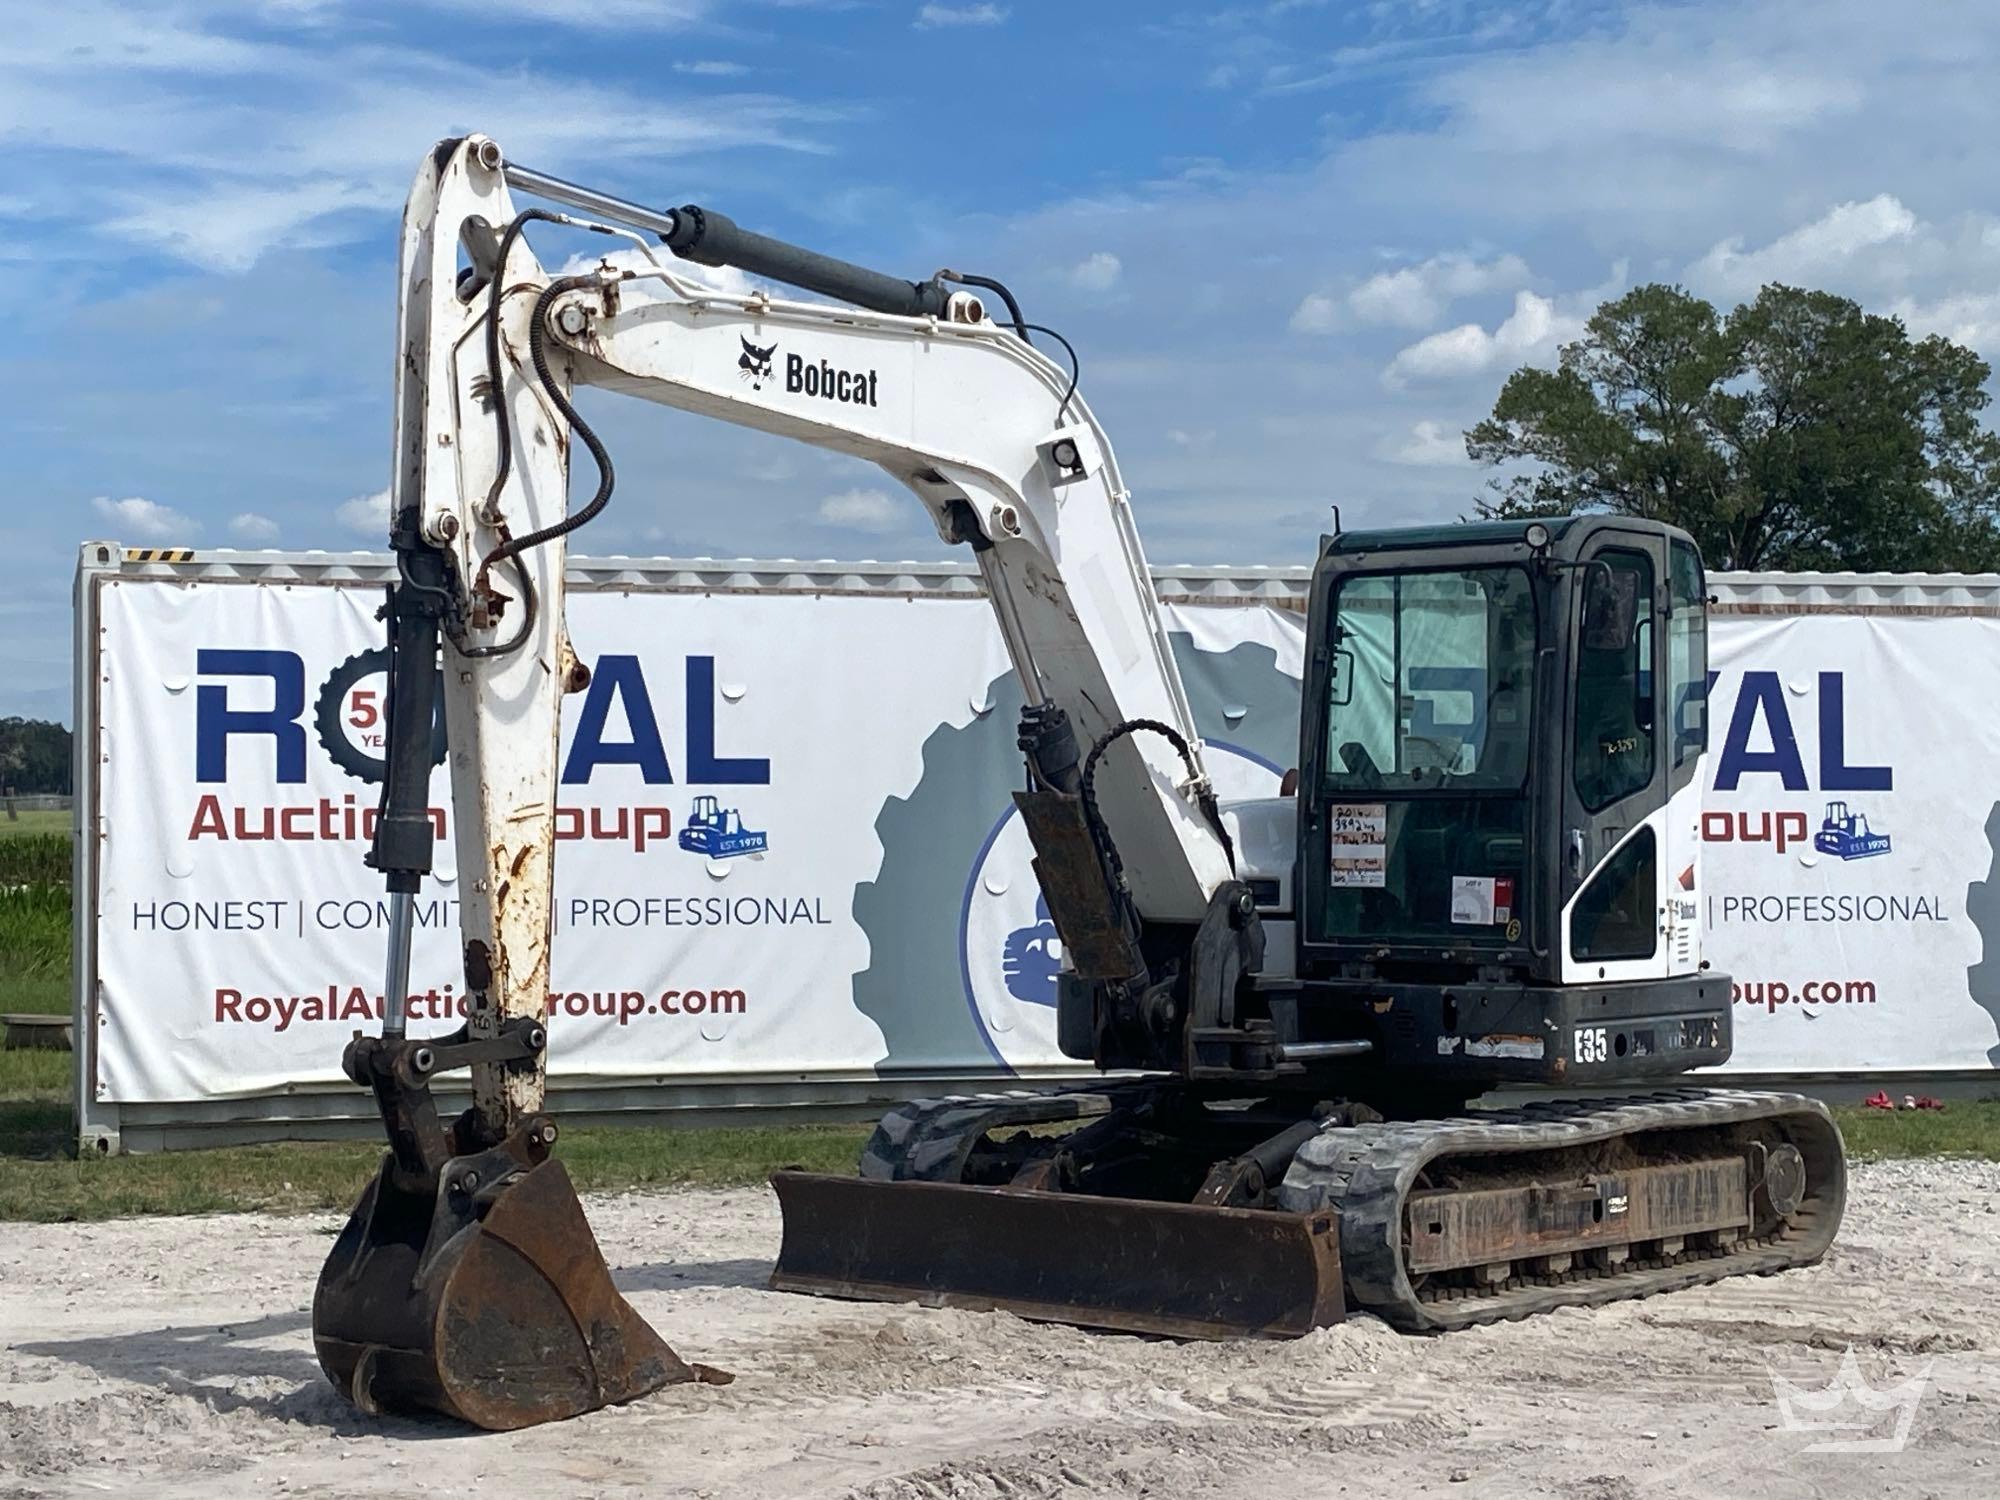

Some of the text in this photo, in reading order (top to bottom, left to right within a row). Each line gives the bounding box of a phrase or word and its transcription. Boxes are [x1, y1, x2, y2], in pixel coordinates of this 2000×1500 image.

[786, 352, 877, 408] Bobcat
[738, 836, 763, 848] 1970
[1868, 839, 1889, 850] 1970
[133, 901, 288, 931] HONEST
[571, 897, 832, 927] PROFESSIONAL
[1723, 895, 1948, 922] PROFESSIONAL
